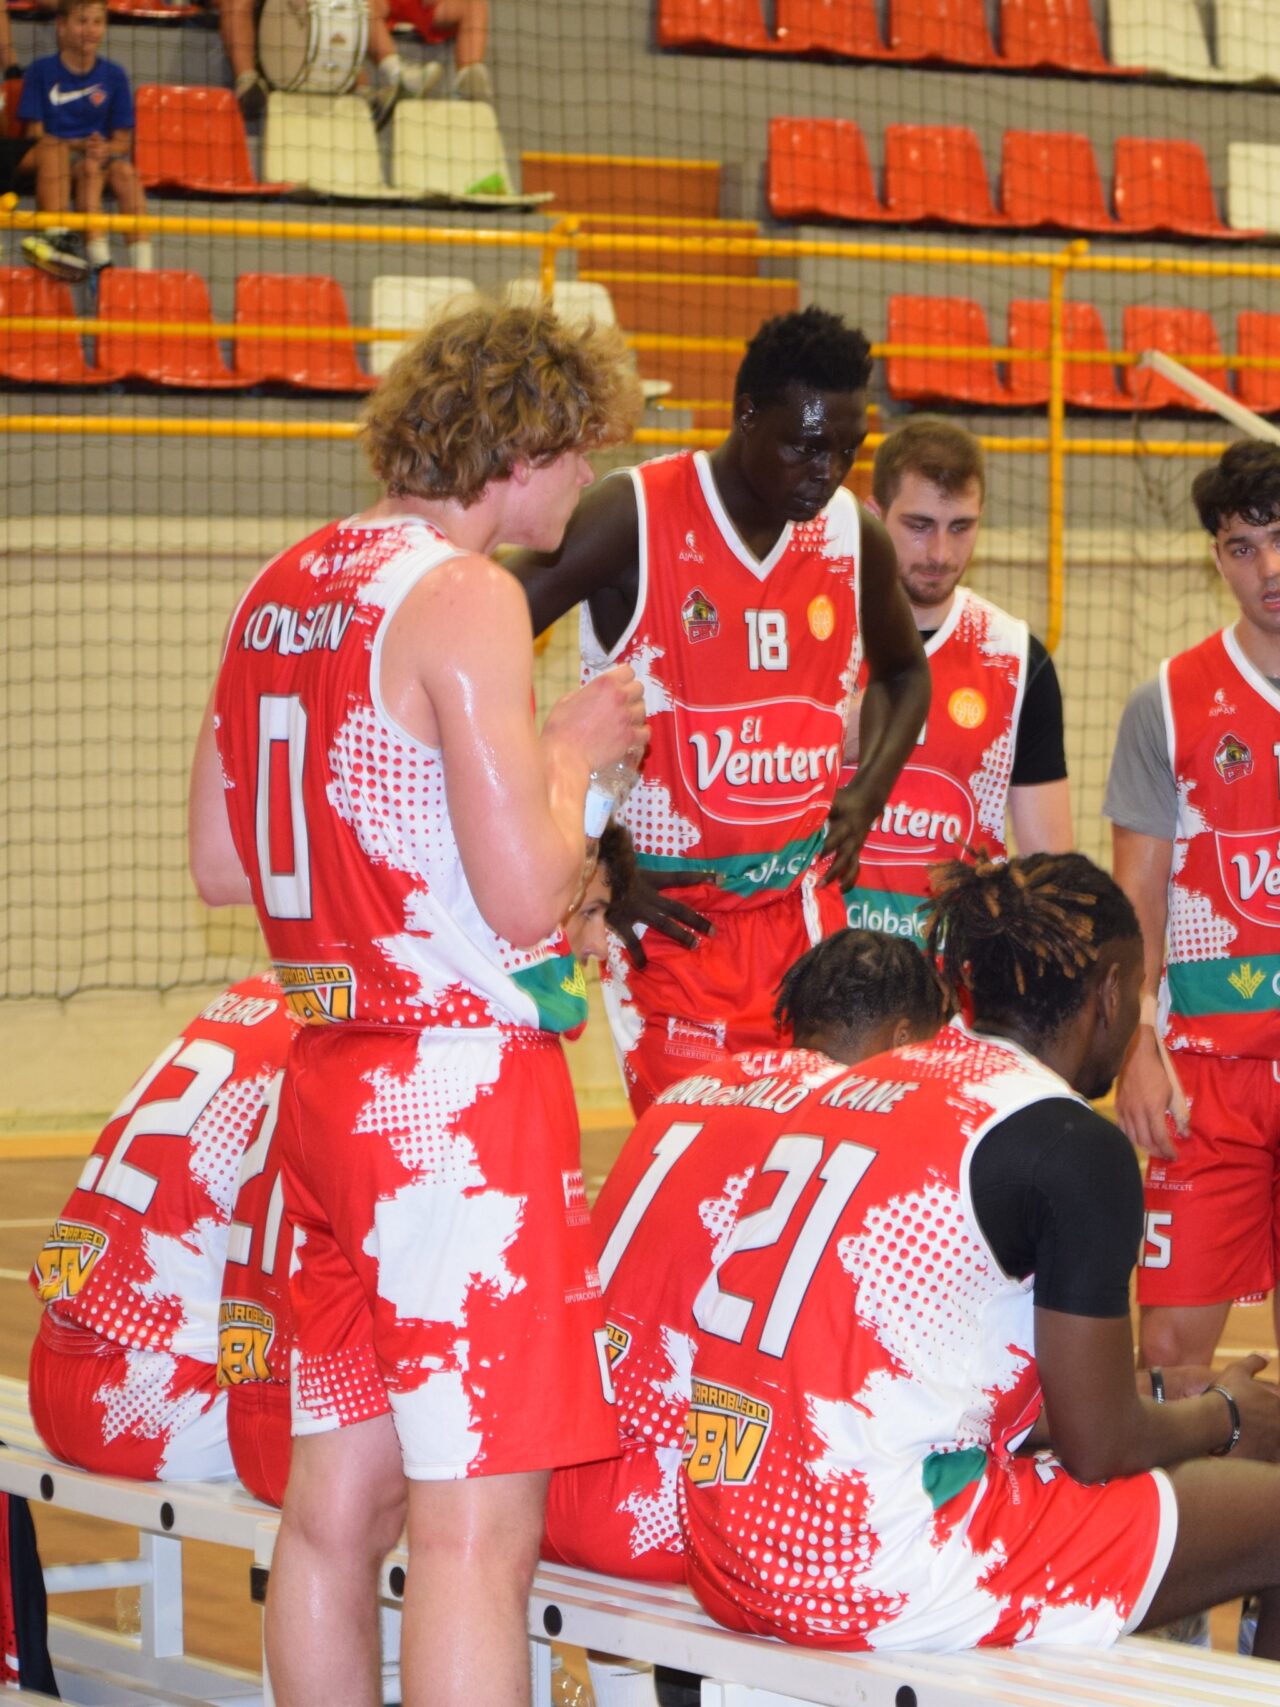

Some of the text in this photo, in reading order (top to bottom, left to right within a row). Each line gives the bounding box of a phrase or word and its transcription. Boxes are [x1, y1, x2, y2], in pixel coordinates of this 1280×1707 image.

[745, 609, 788, 672] 18
[739, 717, 763, 743] El
[255, 694, 312, 919] 0
[871, 802, 961, 843] ntero
[847, 902, 928, 938] Global
[820, 1075, 920, 1114] KANE
[598, 1121, 703, 1295] 1
[693, 1133, 878, 1359] 21
[1139, 1210, 1173, 1269] 5
[692, 1384, 769, 1422] ARROBLEDO
